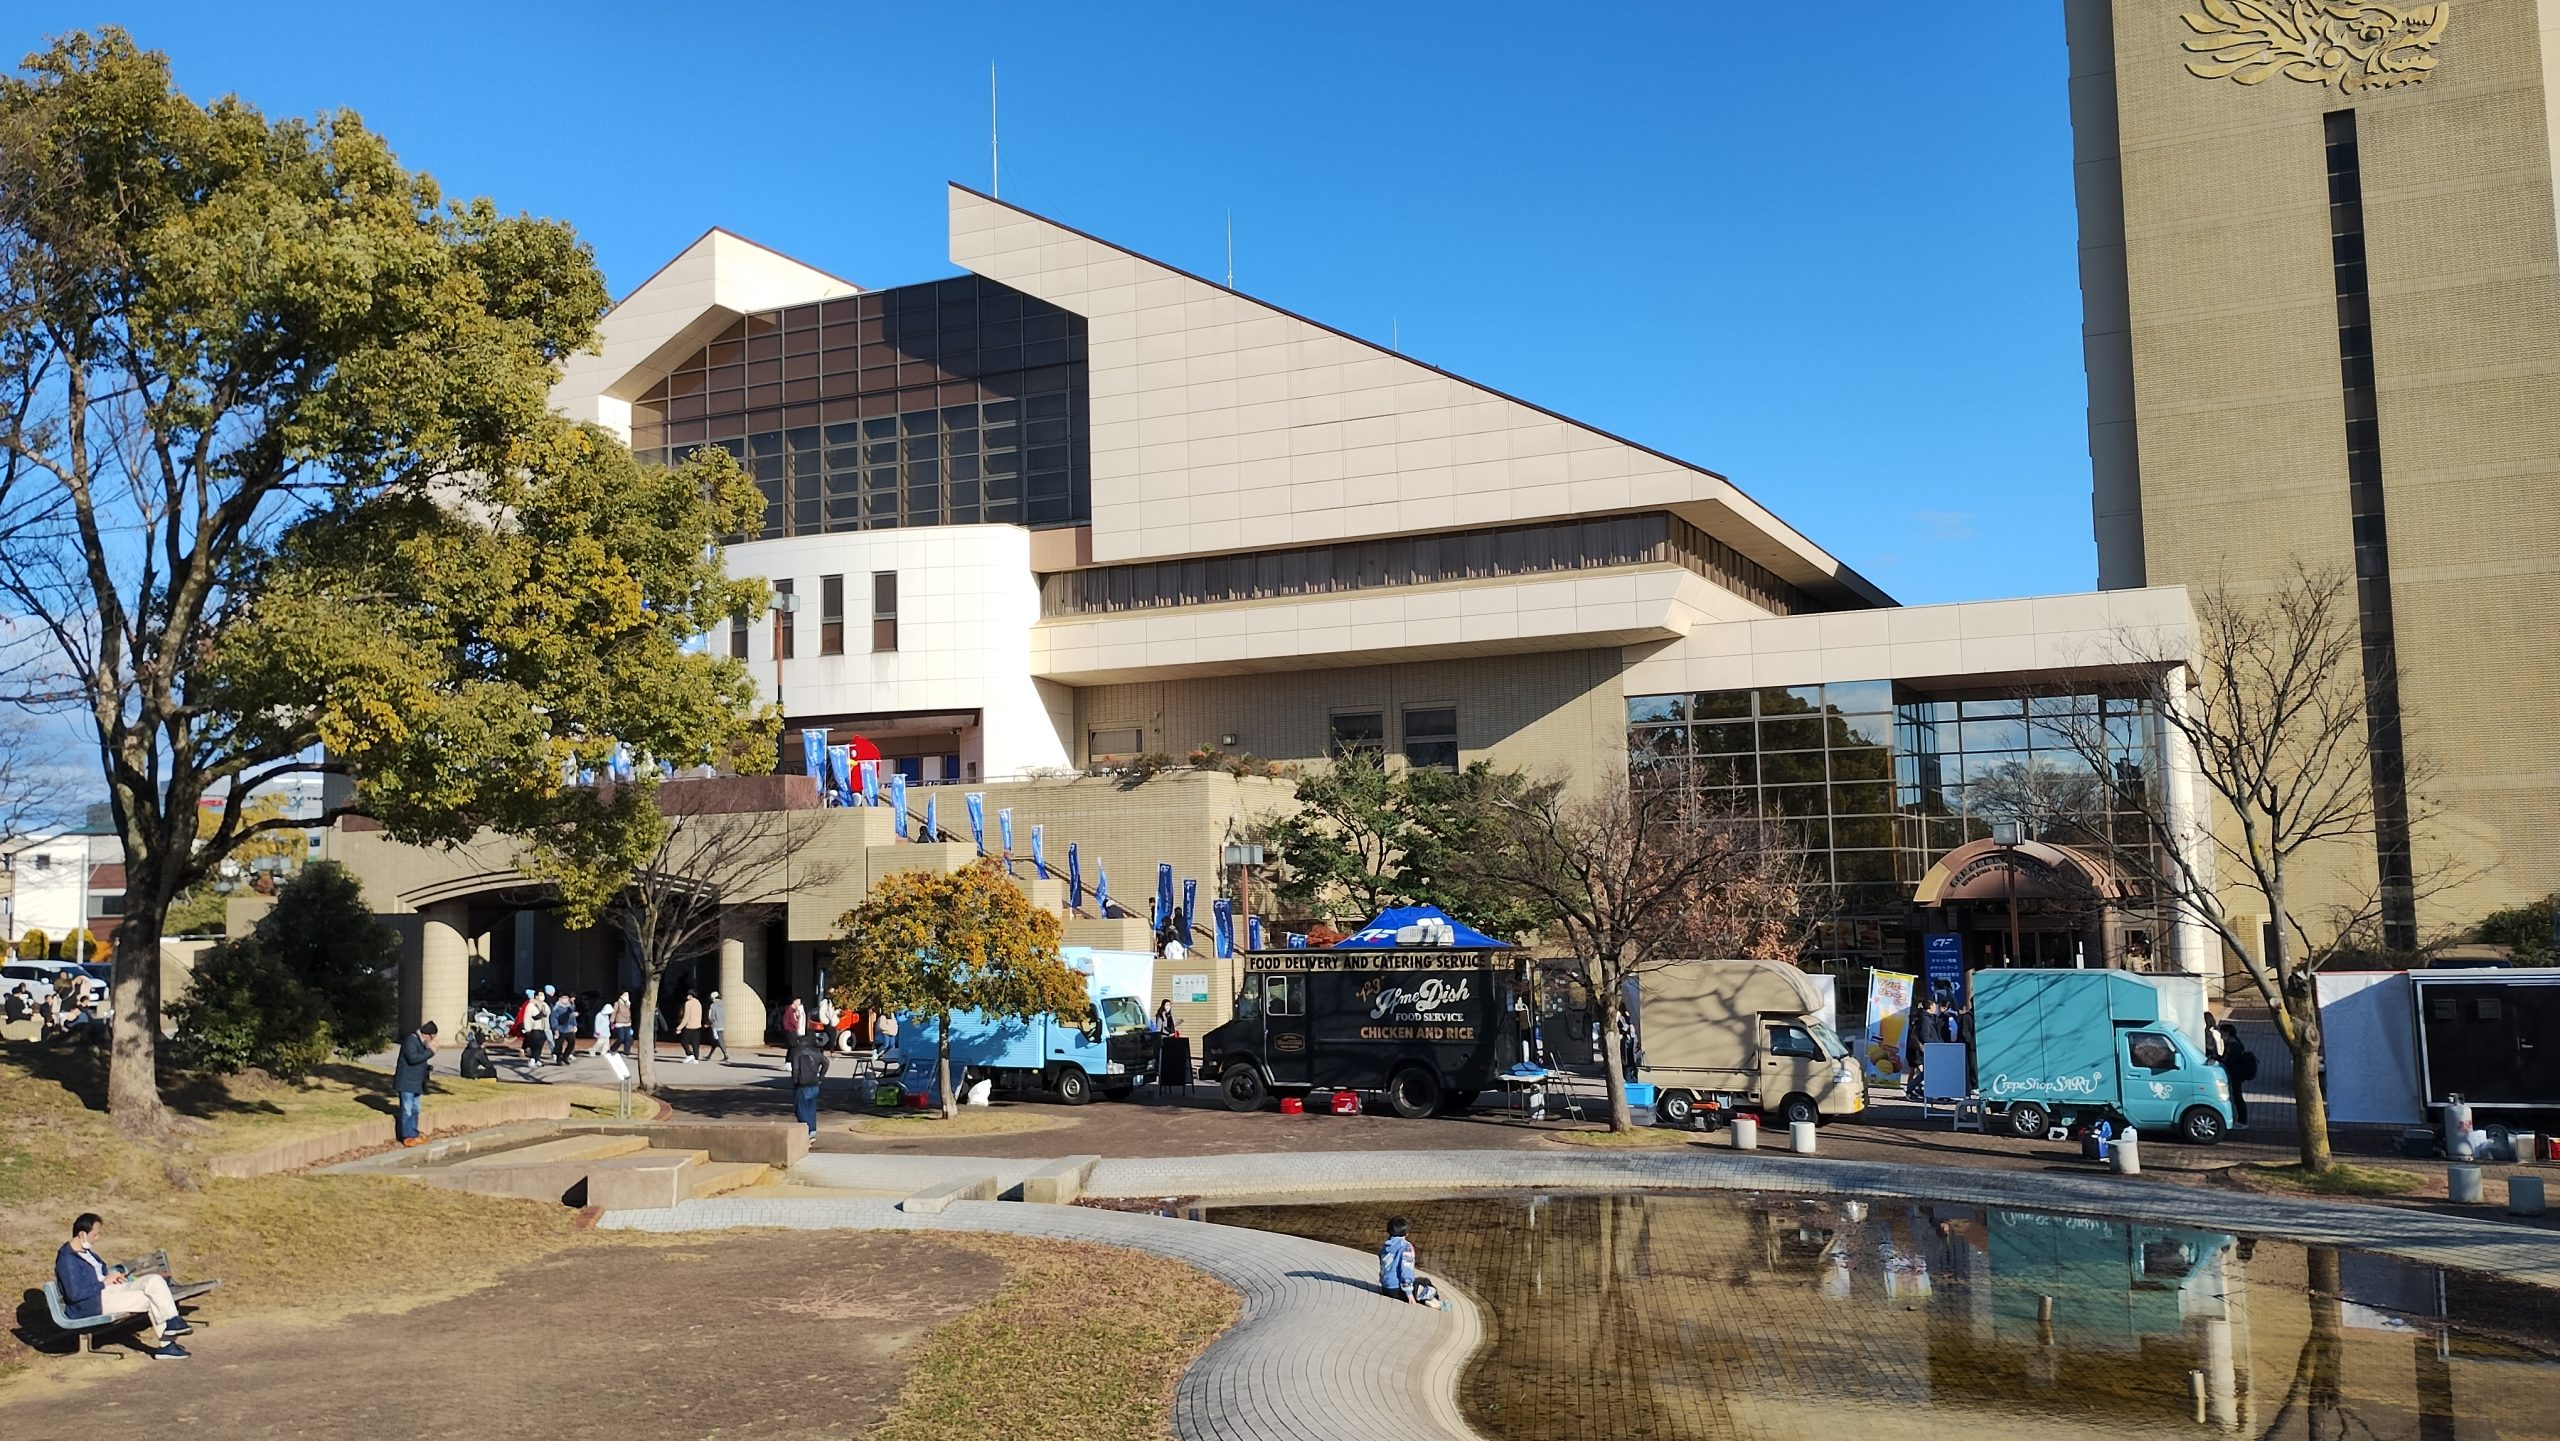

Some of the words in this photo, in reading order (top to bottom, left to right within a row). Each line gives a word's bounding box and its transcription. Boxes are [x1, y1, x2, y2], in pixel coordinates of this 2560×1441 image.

[1250, 957, 1281, 969] FOOD
[1285, 957, 1338, 969] DELIVERY
[1344, 956, 1368, 969] AND
[1373, 955, 1432, 969] CATERING
[1436, 954, 1486, 968] SERVICE
[1415, 978, 1470, 1012] Dish
[1395, 1013, 1421, 1022] FOOD
[1423, 1012, 1464, 1022] SERVICE
[1360, 1027, 1415, 1039] CHICKEN
[1417, 1027, 1444, 1039] AND
[1446, 1027, 1474, 1040] RICE
